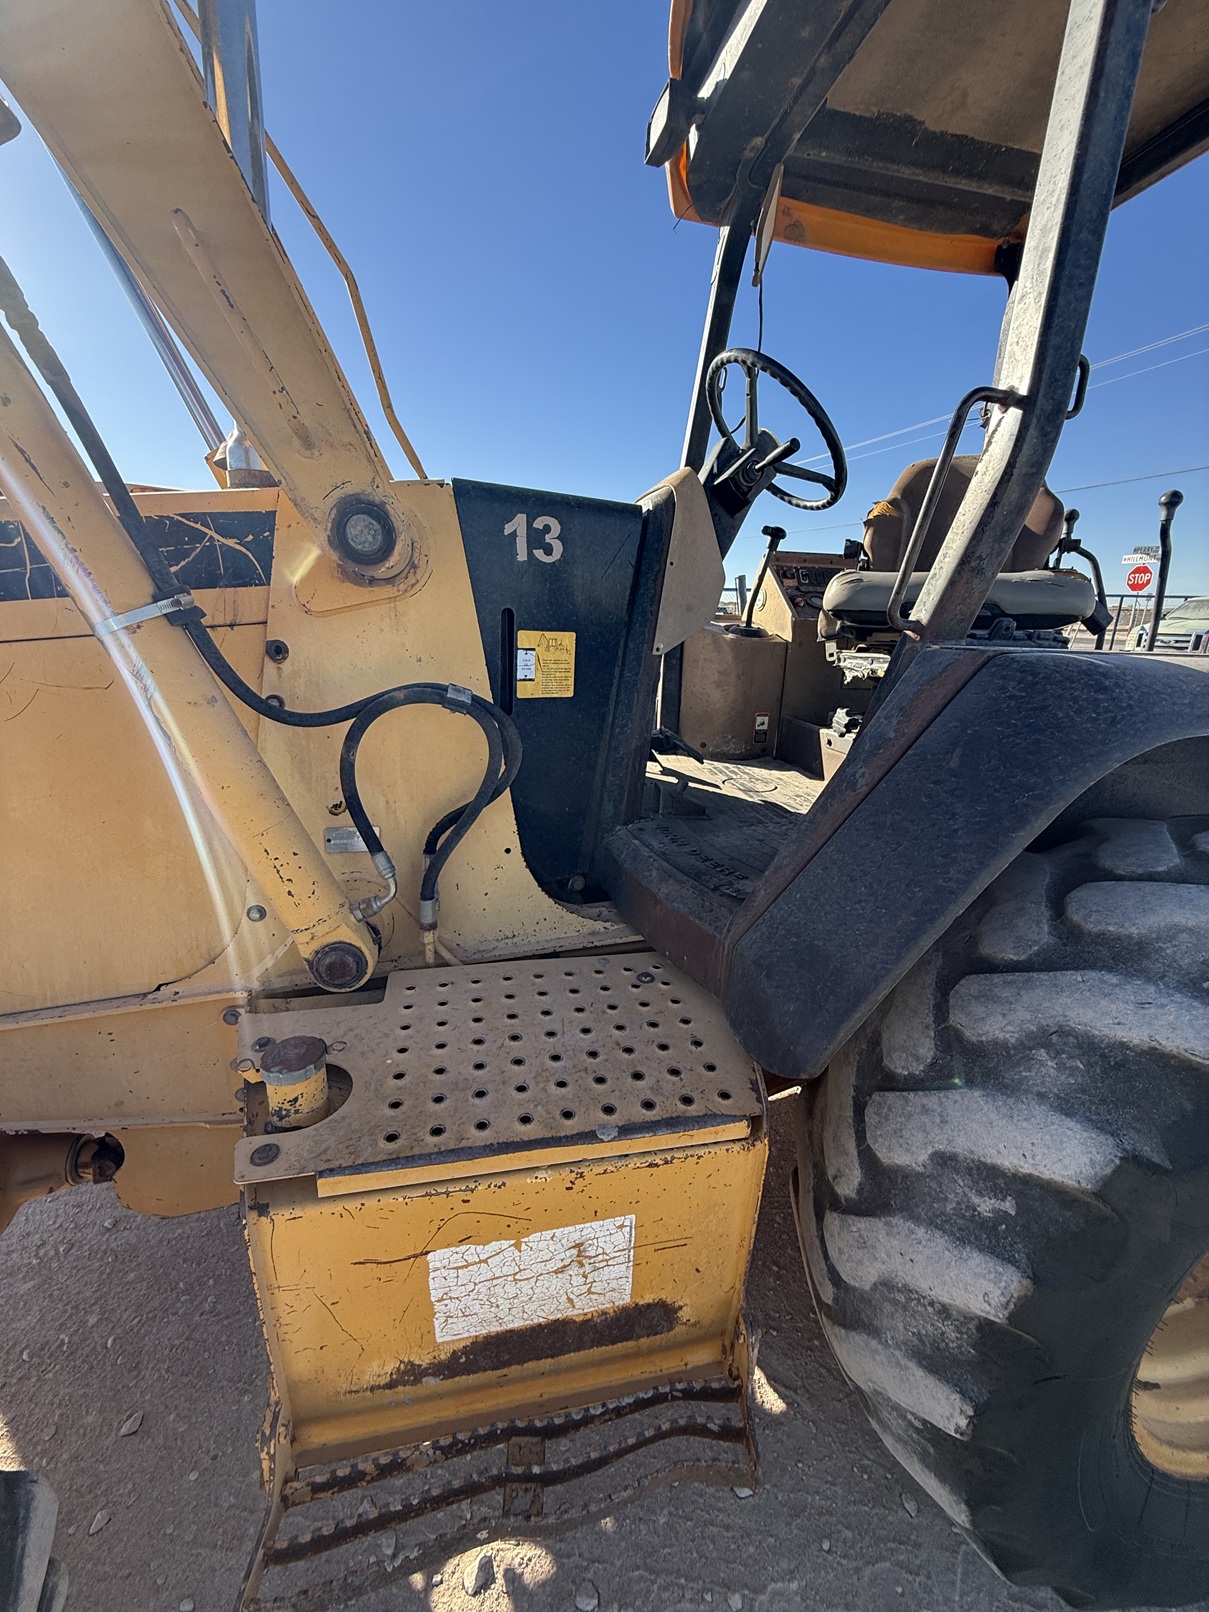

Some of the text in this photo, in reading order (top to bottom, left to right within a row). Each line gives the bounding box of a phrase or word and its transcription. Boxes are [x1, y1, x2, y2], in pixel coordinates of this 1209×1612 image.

[503, 513, 564, 563] 13
[1126, 554, 1157, 562] HILLMONT
[1128, 573, 1151, 584] STOP
